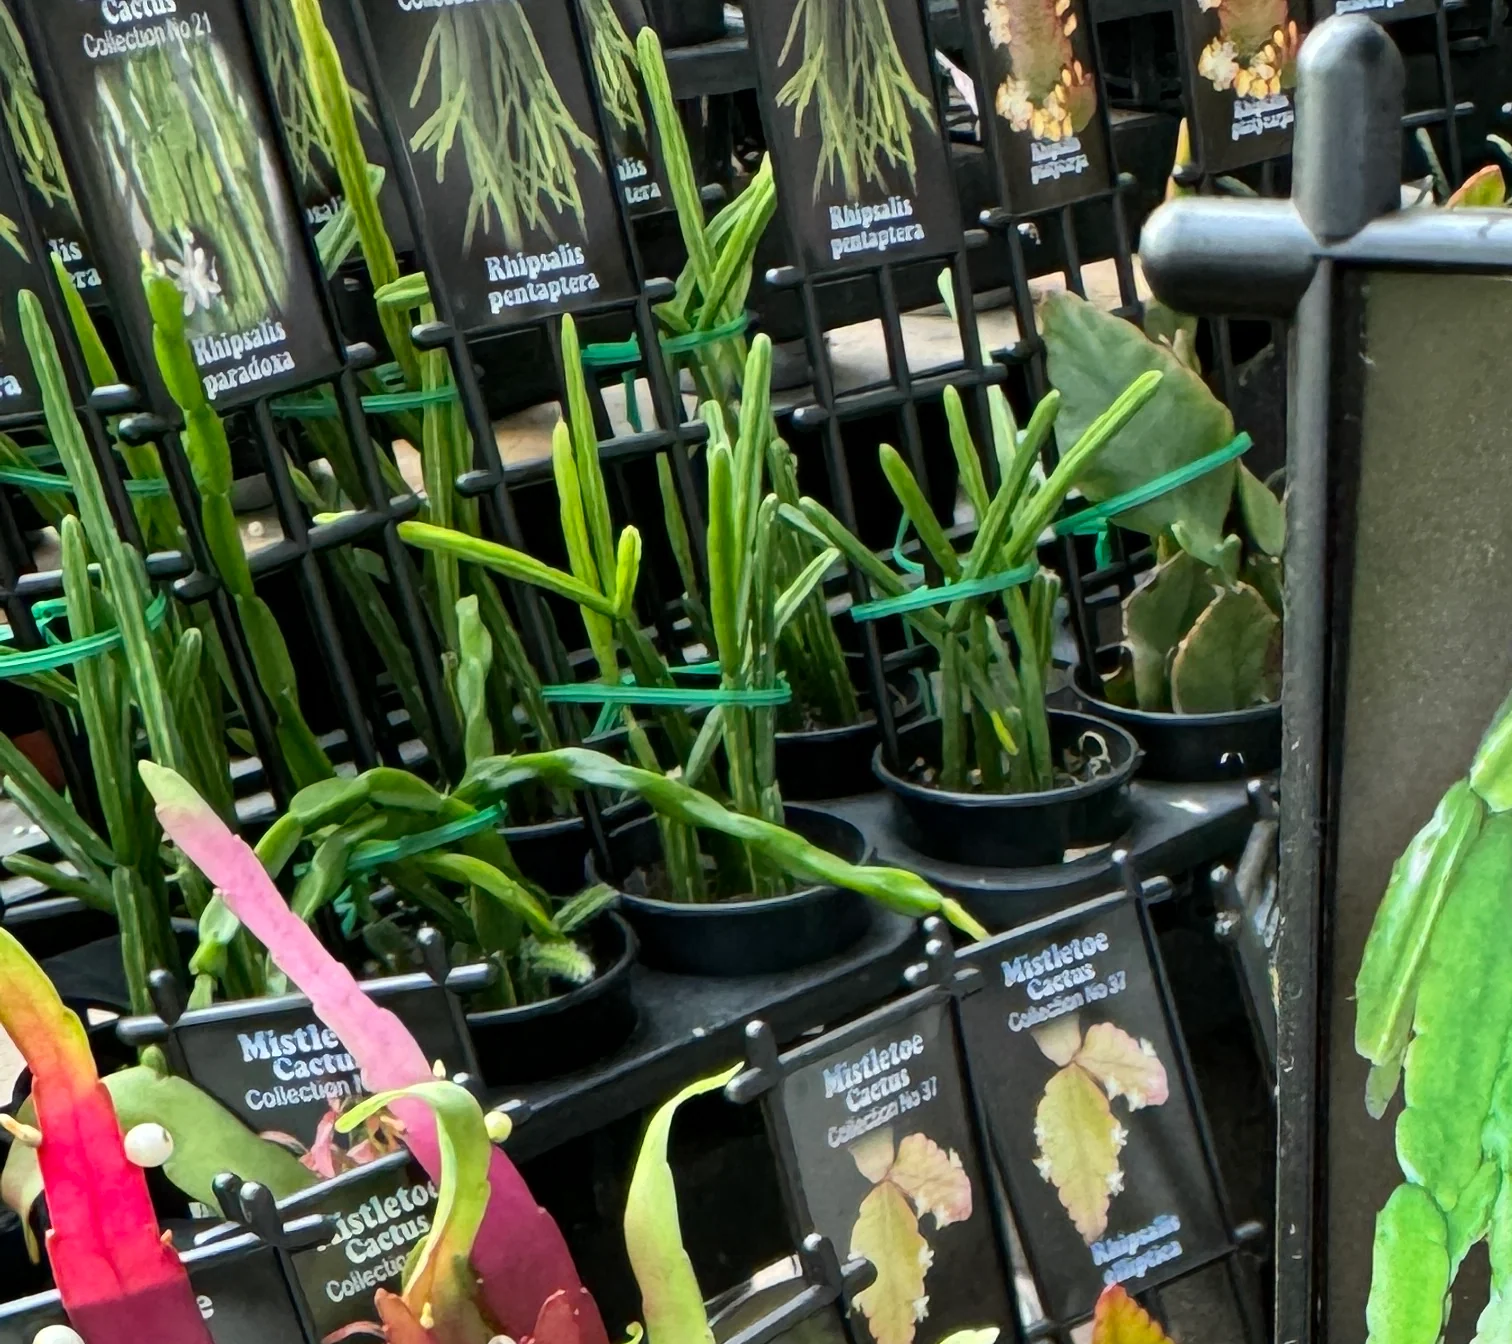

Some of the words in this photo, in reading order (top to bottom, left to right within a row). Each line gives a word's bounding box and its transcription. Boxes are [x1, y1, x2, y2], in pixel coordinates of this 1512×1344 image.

[83, 26, 166, 58] Collection
[190, 11, 211, 36] 21
[485, 243, 584, 281] Rhipsalis
[488, 273, 600, 314] pentaptera
[192, 317, 286, 366] Rhipsalis
[1001, 932, 1109, 987] Mistletoe
[1026, 963, 1096, 1000] Cactus
[237, 1023, 339, 1062] Mistle
[272, 1052, 356, 1081] Cactu
[822, 1034, 924, 1098] Mistletoe
[245, 1079, 351, 1110] Collection
[846, 1068, 910, 1112] Cactus
[318, 1181, 439, 1250] istleto
[345, 1215, 430, 1264] Cactus
[326, 1255, 407, 1302] Collectio
